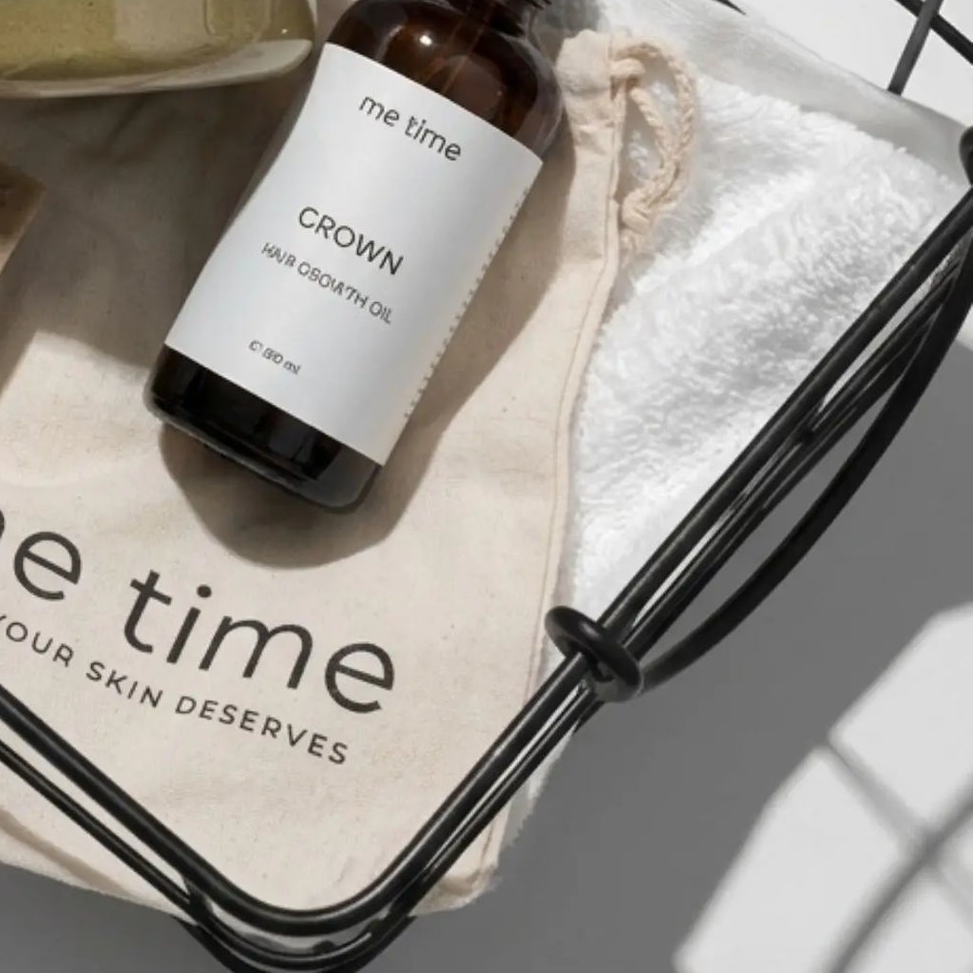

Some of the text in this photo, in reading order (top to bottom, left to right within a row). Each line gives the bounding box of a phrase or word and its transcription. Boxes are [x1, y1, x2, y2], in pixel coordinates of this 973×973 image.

[359, 97, 461, 161] me time
[299, 207, 404, 275] CROWN
[369, 301, 391, 324] OIL
[123, 570, 395, 714] time
[85, 661, 163, 709] SKIN
[175, 695, 349, 766] DESERVES
